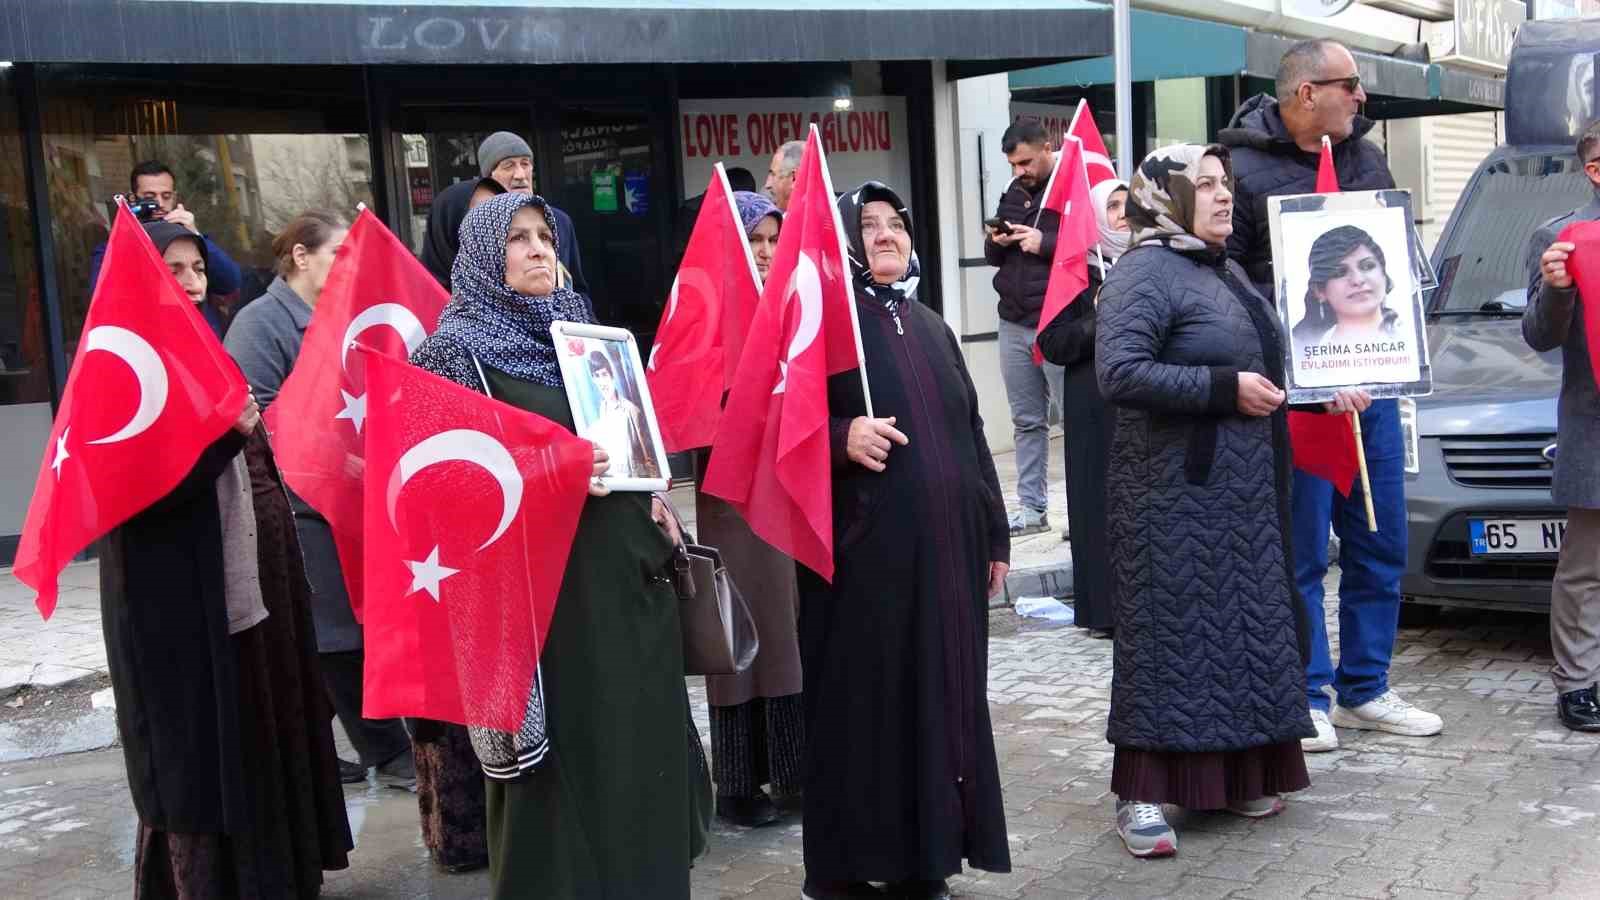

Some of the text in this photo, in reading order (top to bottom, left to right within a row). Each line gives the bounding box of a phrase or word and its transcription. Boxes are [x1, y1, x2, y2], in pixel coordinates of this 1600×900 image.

[683, 114, 740, 158] LOVE
[1304, 341, 1406, 359] ŞERİMA SANCAR
[1487, 524, 1517, 549] 65
